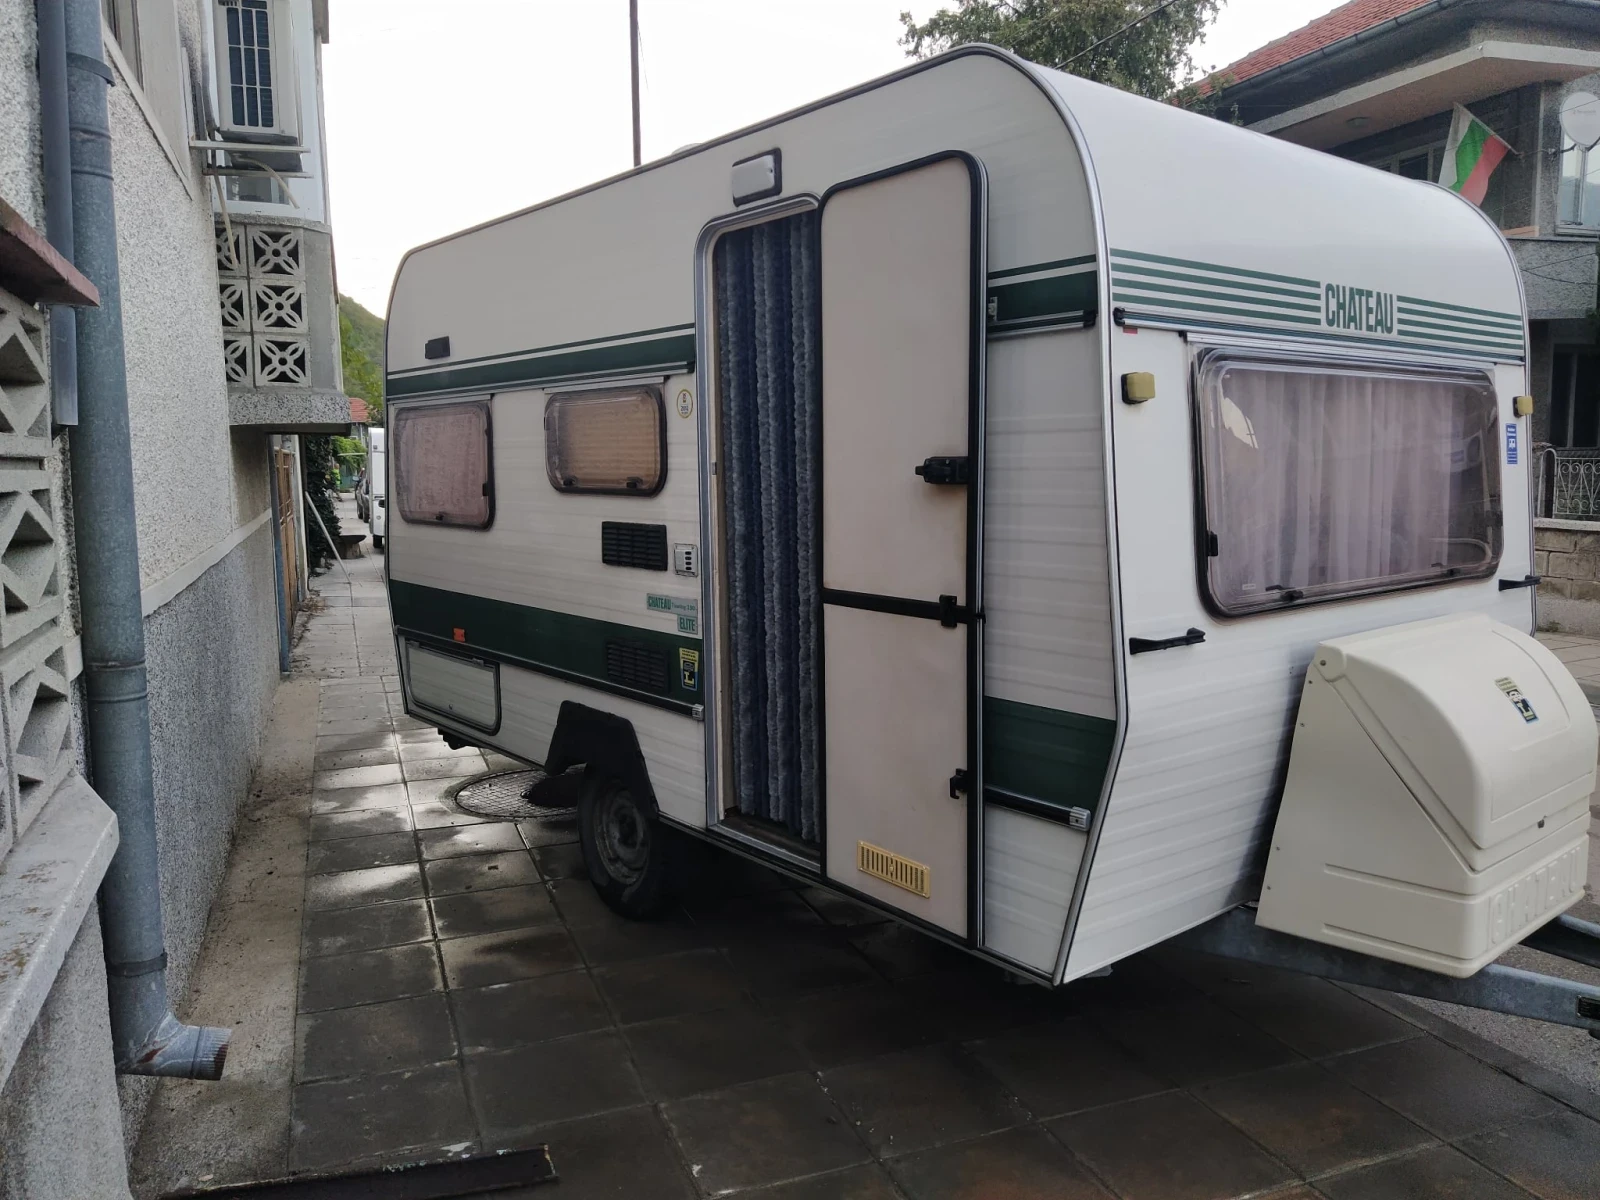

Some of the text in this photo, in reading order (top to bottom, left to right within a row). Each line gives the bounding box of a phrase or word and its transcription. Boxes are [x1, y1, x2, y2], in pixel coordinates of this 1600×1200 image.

[1325, 283, 1393, 334] CHATEAU
[648, 596, 672, 610] CHATEAU
[679, 617, 696, 632] ELITE
[1492, 846, 1581, 944] CHATEAU
